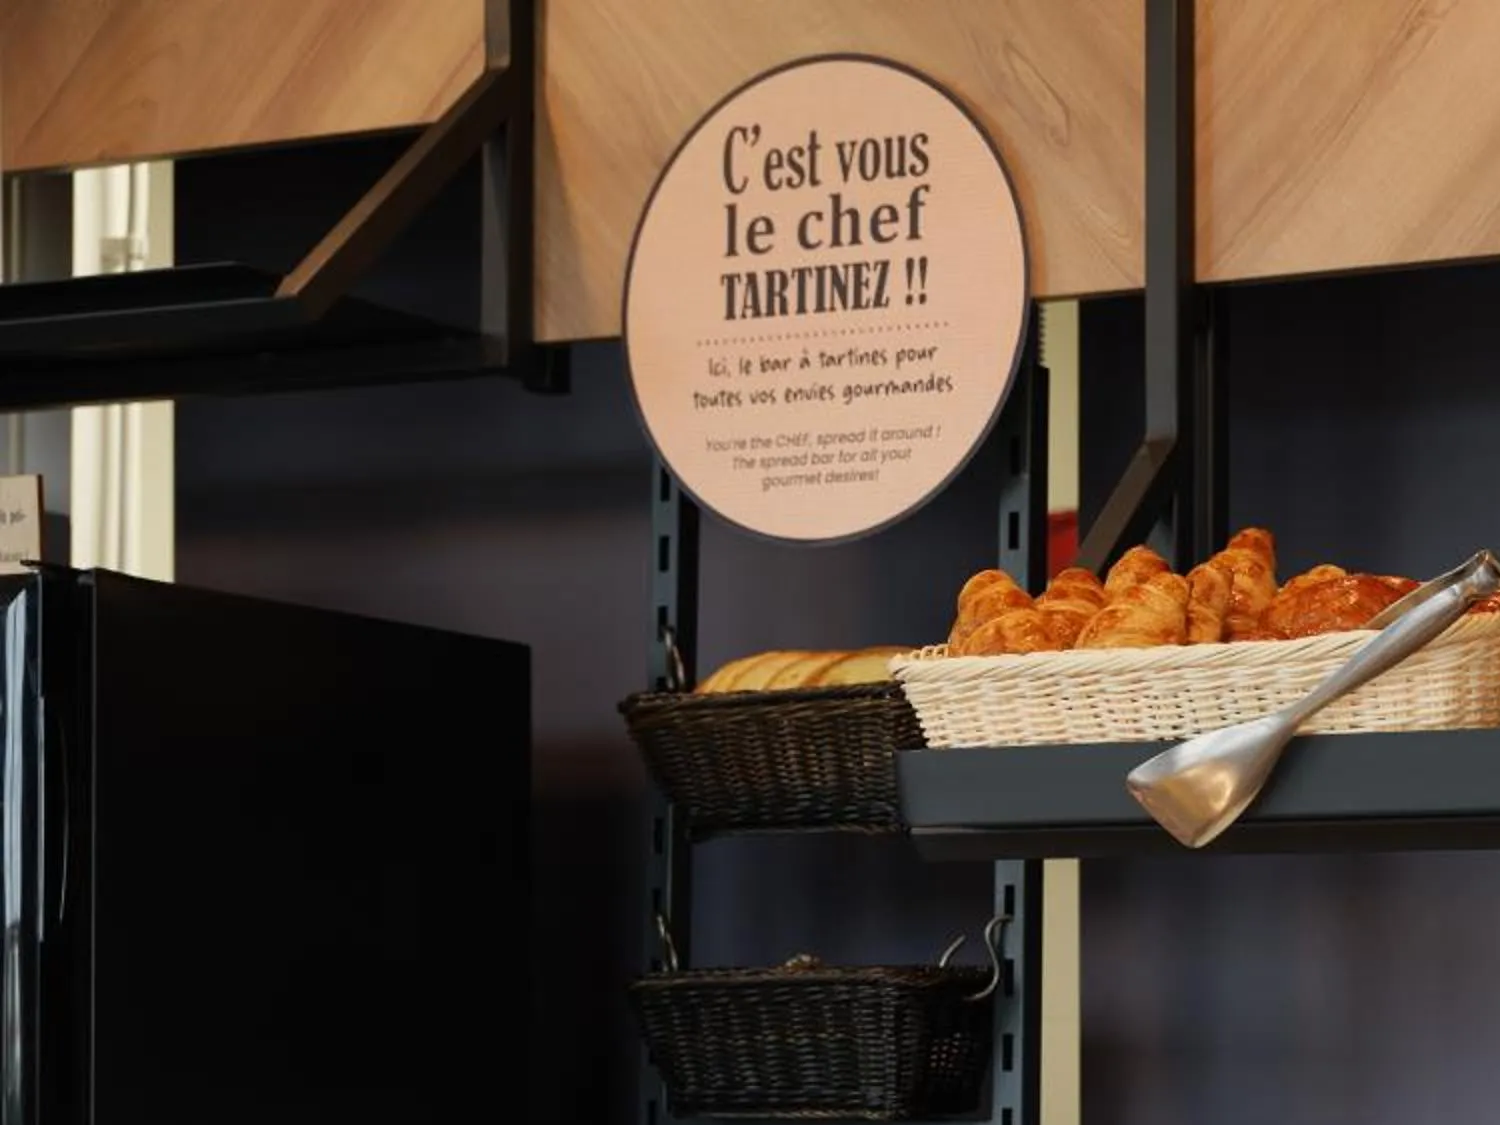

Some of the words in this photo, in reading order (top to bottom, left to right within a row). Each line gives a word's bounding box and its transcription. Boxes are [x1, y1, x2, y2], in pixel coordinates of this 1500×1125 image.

[835, 133, 930, 184] vous
[724, 202, 775, 258] le
[797, 184, 931, 250] chef
[720, 258, 891, 321] TARTINEZ
[905, 255, 929, 306] !!
[708, 356, 731, 378] Ici,
[739, 357, 752, 376] le
[759, 355, 792, 374] bar
[799, 349, 811, 370] à
[818, 347, 888, 369] tartines
[895, 345, 939, 370] pour
[692, 388, 743, 411] toutes
[750, 389, 777, 406] vos
[784, 382, 836, 404] envies
[842, 372, 954, 405] gourmandes
[750, 434, 773, 449] the
[775, 432, 814, 449] CHEF,
[817, 429, 866, 450] spread
[869, 426, 879, 443] it
[881, 424, 933, 442] around
[935, 425, 942, 438] !
[732, 455, 757, 471] The
[759, 453, 809, 471] spread
[811, 450, 835, 466] bar
[838, 449, 856, 464] for
[859, 448, 880, 463] all
[880, 448, 912, 466] your
[761, 472, 823, 492] gourmet
[824, 467, 881, 485] desires!
